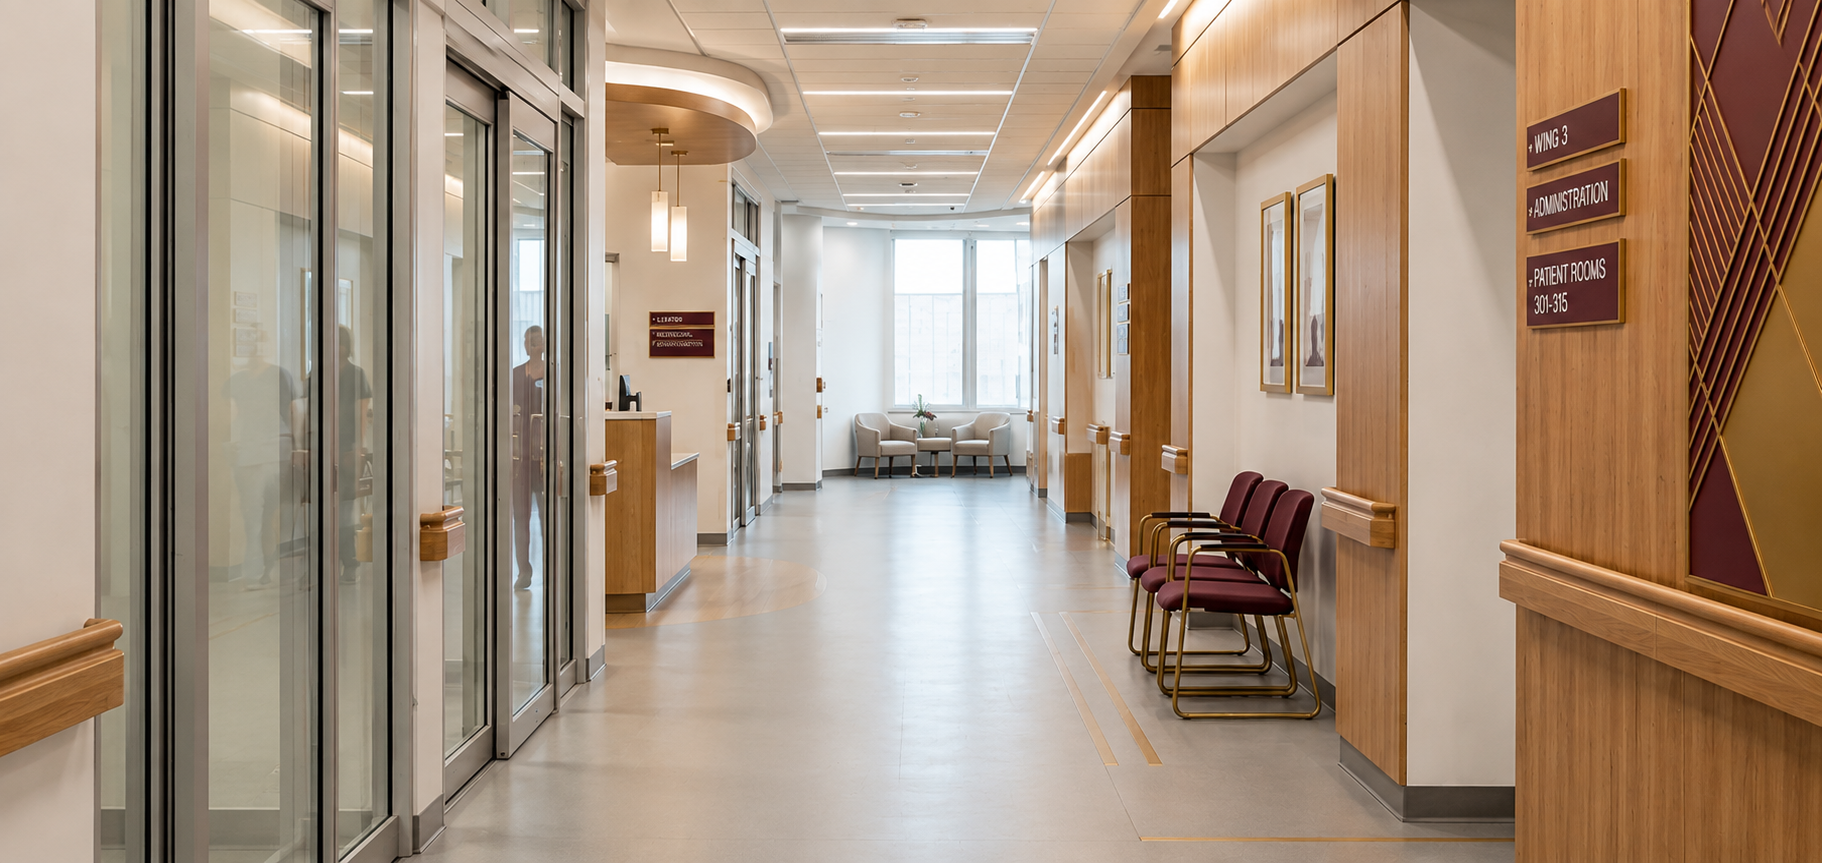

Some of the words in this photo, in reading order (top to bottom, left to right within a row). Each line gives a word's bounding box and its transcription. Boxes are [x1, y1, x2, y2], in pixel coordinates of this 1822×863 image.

[1534, 128, 1559, 154] WING
[1561, 125, 1568, 145] 3
[1533, 180, 1609, 218] ADMINISTRATION
[1534, 264, 1568, 288] PATIENT
[1570, 258, 1606, 282] ROOMS
[1534, 292, 1568, 315] 301-315
